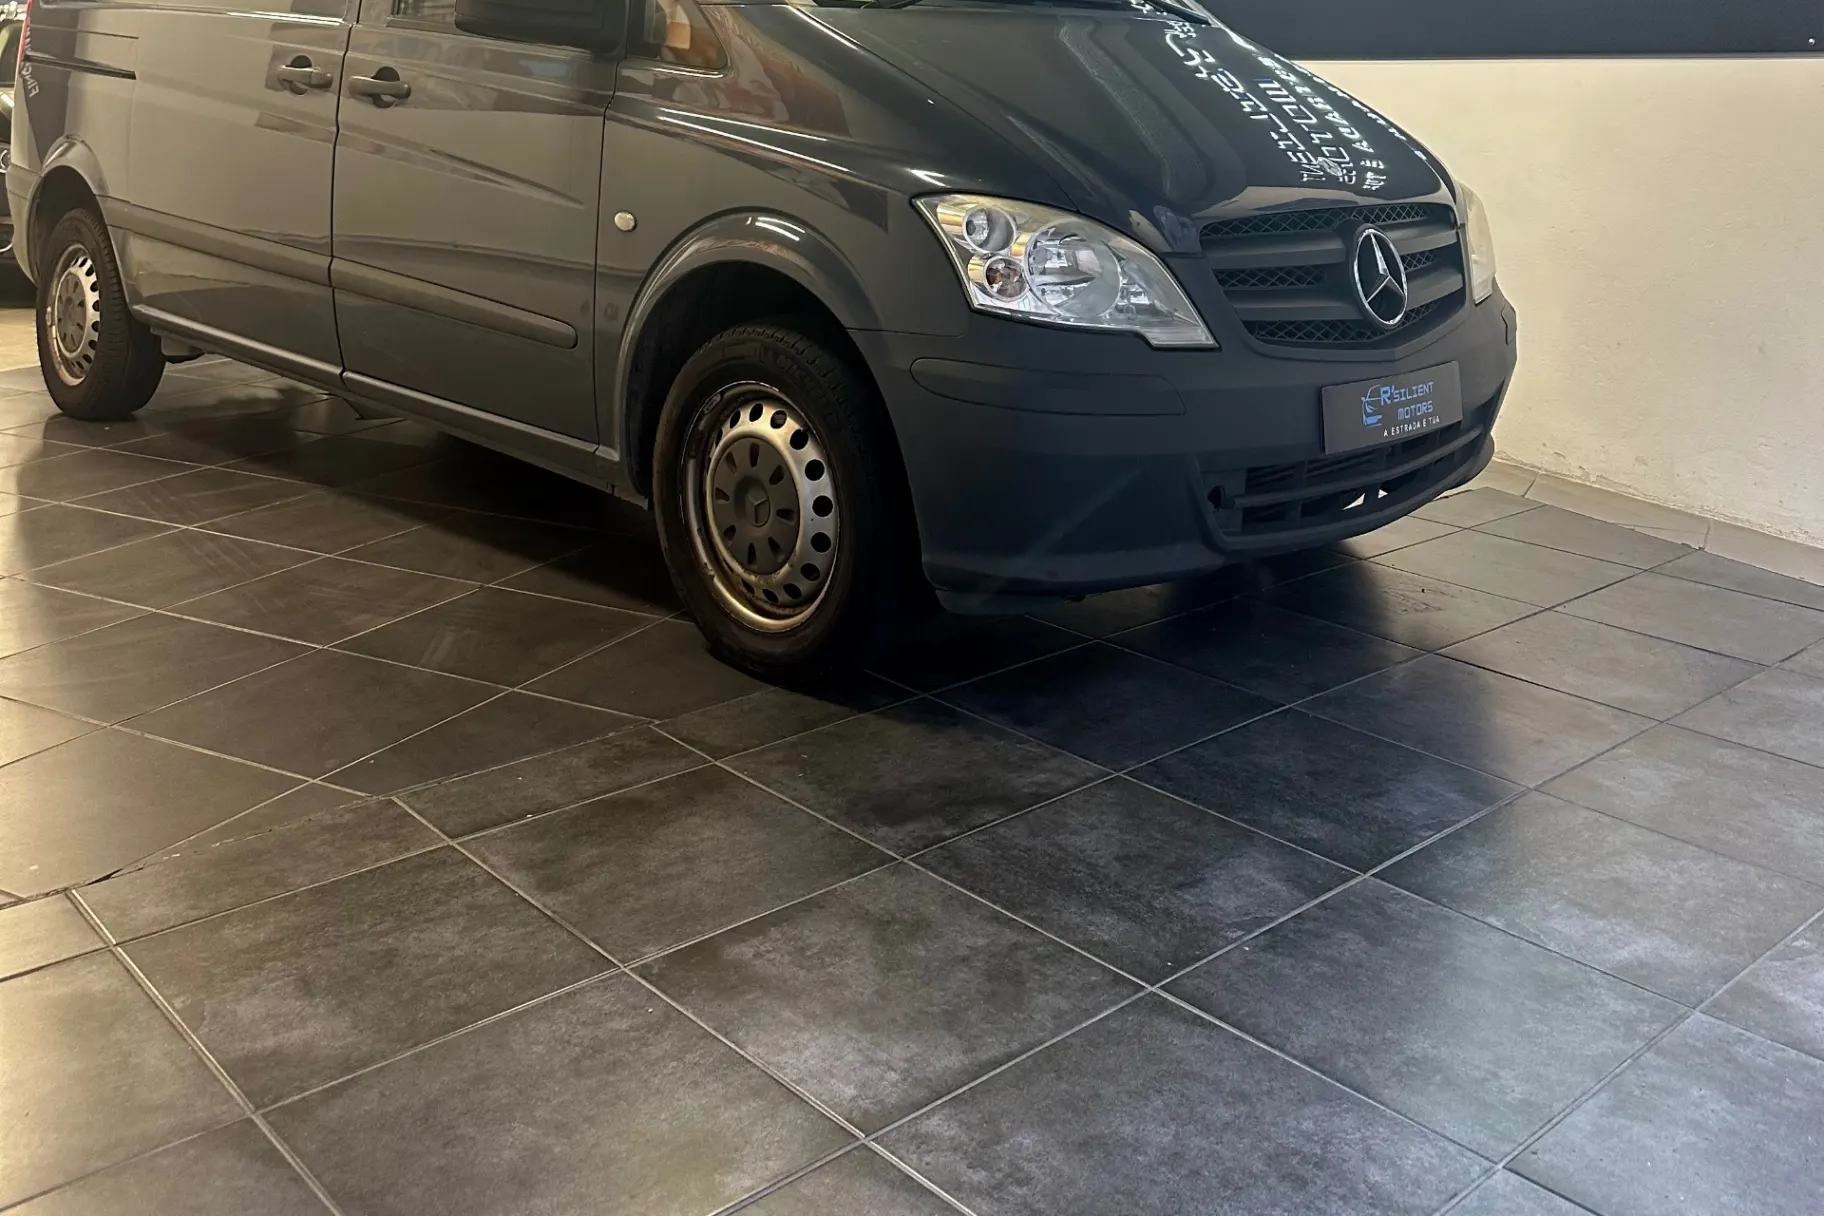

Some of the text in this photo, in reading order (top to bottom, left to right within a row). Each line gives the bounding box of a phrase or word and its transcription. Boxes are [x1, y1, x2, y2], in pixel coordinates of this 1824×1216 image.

[1397, 401, 1434, 420] MOTORS
[1383, 429, 1389, 437] A
[1391, 421, 1421, 436] ESTRADA
[1428, 415, 1440, 425] TUA
